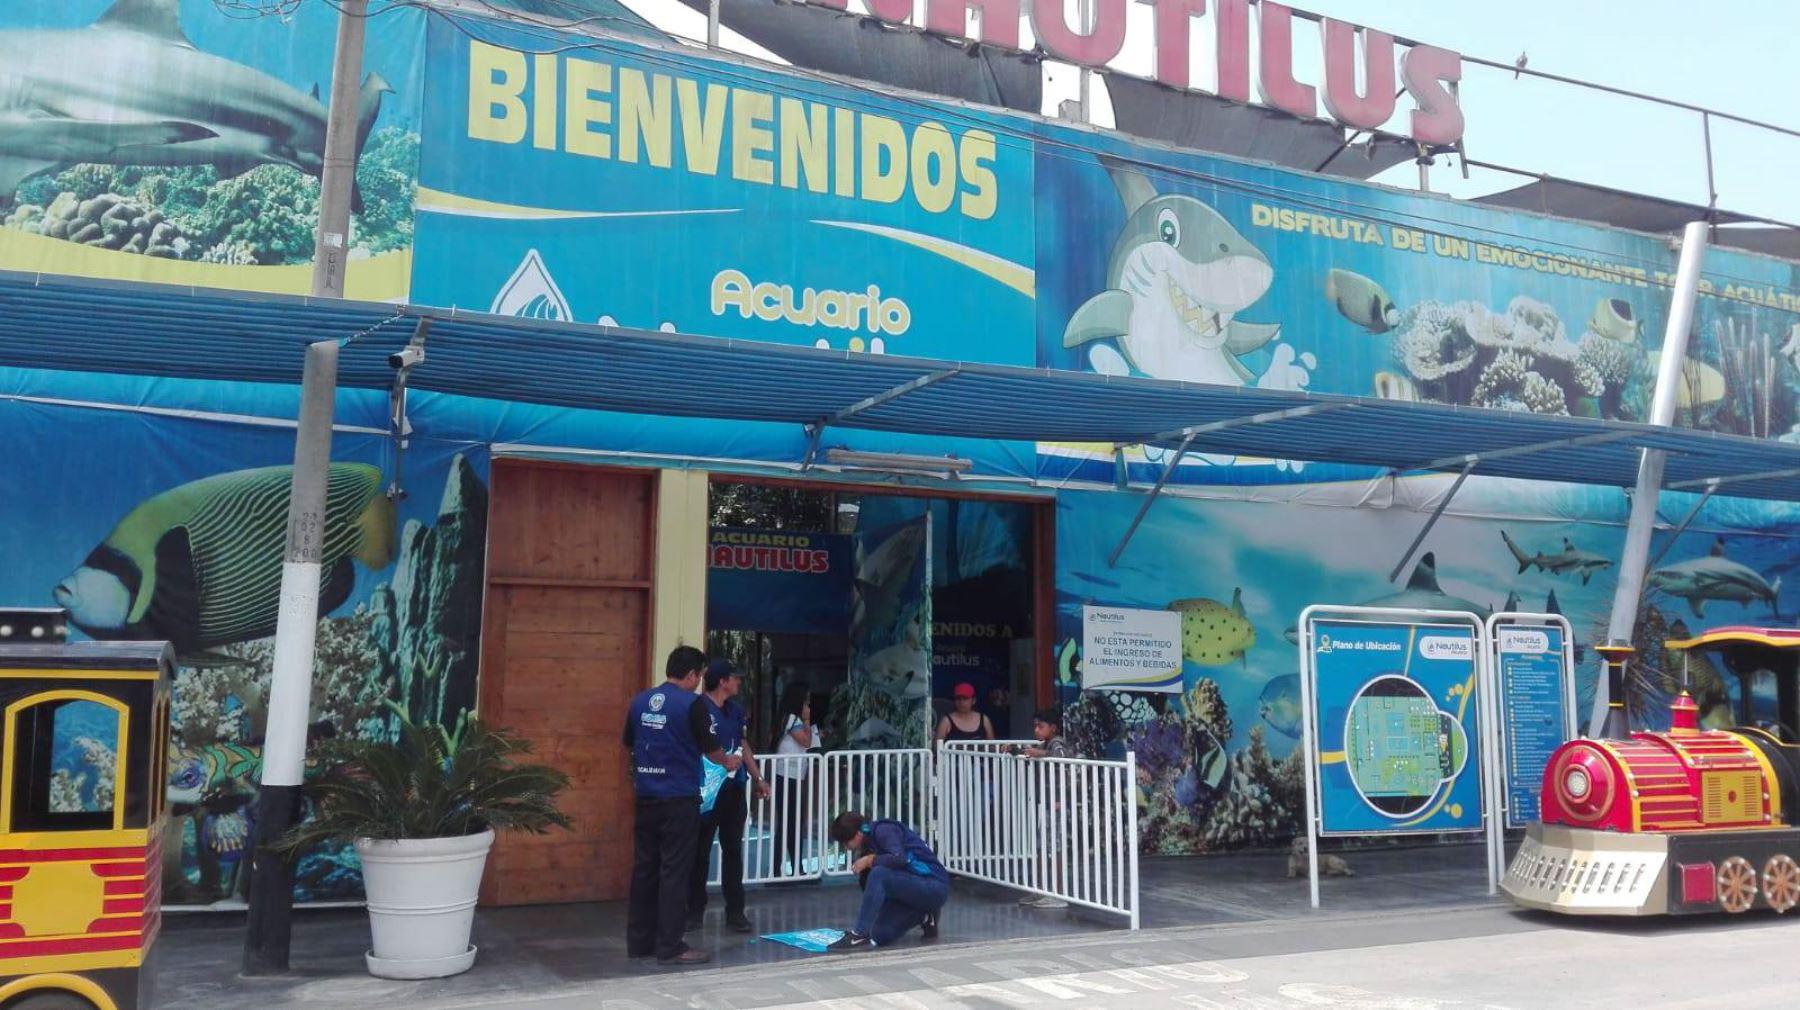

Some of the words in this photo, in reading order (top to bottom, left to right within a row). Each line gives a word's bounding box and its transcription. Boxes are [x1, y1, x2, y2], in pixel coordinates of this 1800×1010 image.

[467, 39, 998, 220] BIENVENIDOS
[1251, 203, 1384, 246] DISFRUTA
[1391, 226, 1427, 254] DE
[1433, 231, 1470, 261] UN
[1475, 240, 1648, 288] EMOCIONANTE
[711, 269, 911, 335] Acuario
[712, 531, 810, 548] ACUARIO
[1094, 636, 1106, 645] NO
[1107, 637, 1128, 646] ESTA
[1129, 638, 1172, 648] PERMITIDO
[1332, 640, 1354, 649] Plano
[1355, 641, 1365, 650] de
[1366, 641, 1402, 651] Ubicación
[1103, 648, 1114, 656] EL
[1115, 648, 1151, 658] INGRESO
[1151, 650, 1163, 658] DE
[1089, 658, 1135, 667] ALIMENTOS
[1142, 660, 1177, 669] BEBIDAS
